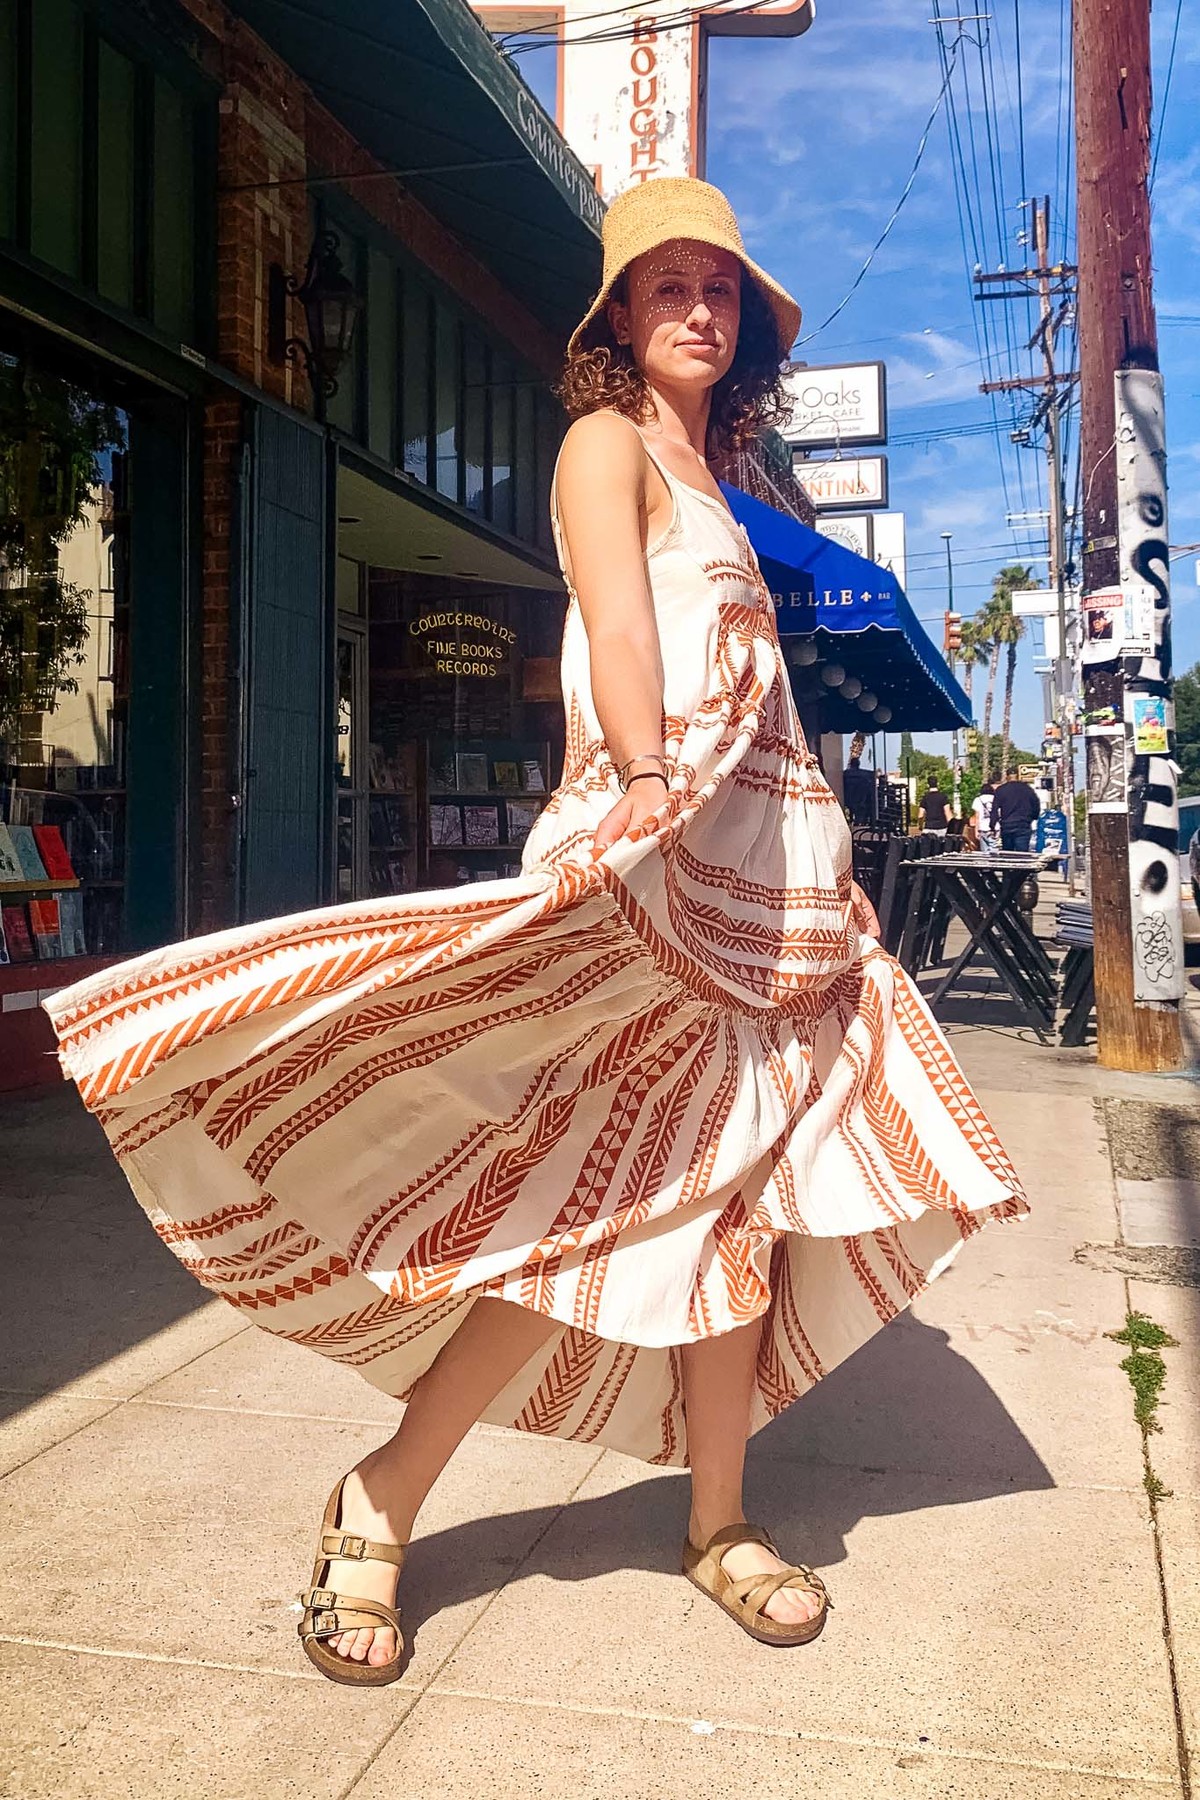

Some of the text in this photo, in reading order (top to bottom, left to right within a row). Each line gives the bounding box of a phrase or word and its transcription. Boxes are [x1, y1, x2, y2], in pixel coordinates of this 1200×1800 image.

[630, 15, 660, 182] BOUGHT
[517, 89, 604, 224] Counterpoi
[802, 379, 861, 408] Oaks
[794, 407, 861, 420] RKET CAFE
[804, 479, 870, 496] NTINA
[773, 590, 853, 608] BELLE
[427, 641, 503, 659] FINE BOOKS
[437, 660, 497, 676] RECORDS
